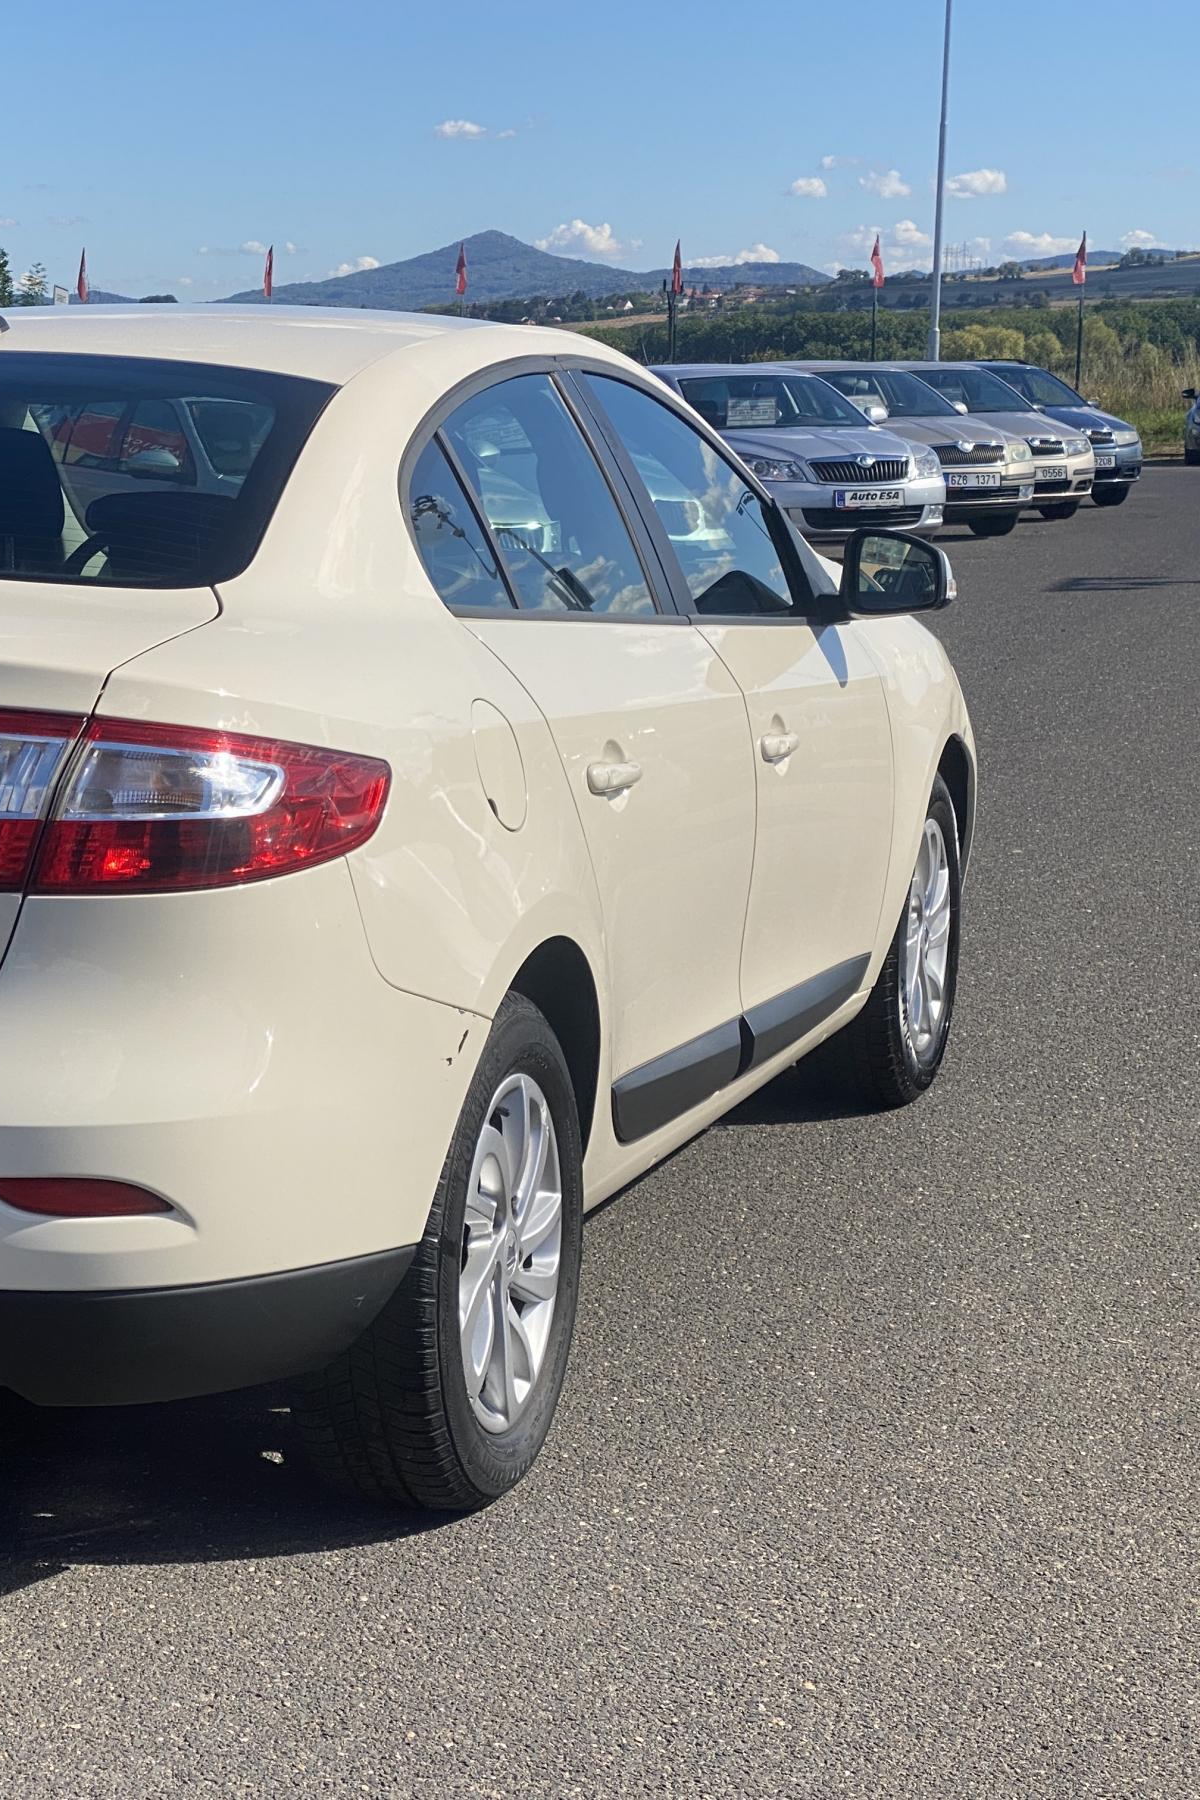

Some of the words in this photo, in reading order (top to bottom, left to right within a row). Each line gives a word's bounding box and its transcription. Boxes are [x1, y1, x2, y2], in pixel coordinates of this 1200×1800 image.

[1042, 468, 1063, 478] 0556
[975, 474, 996, 485] 1371
[849, 492, 878, 501] Auto
[879, 491, 900, 500] ESA
